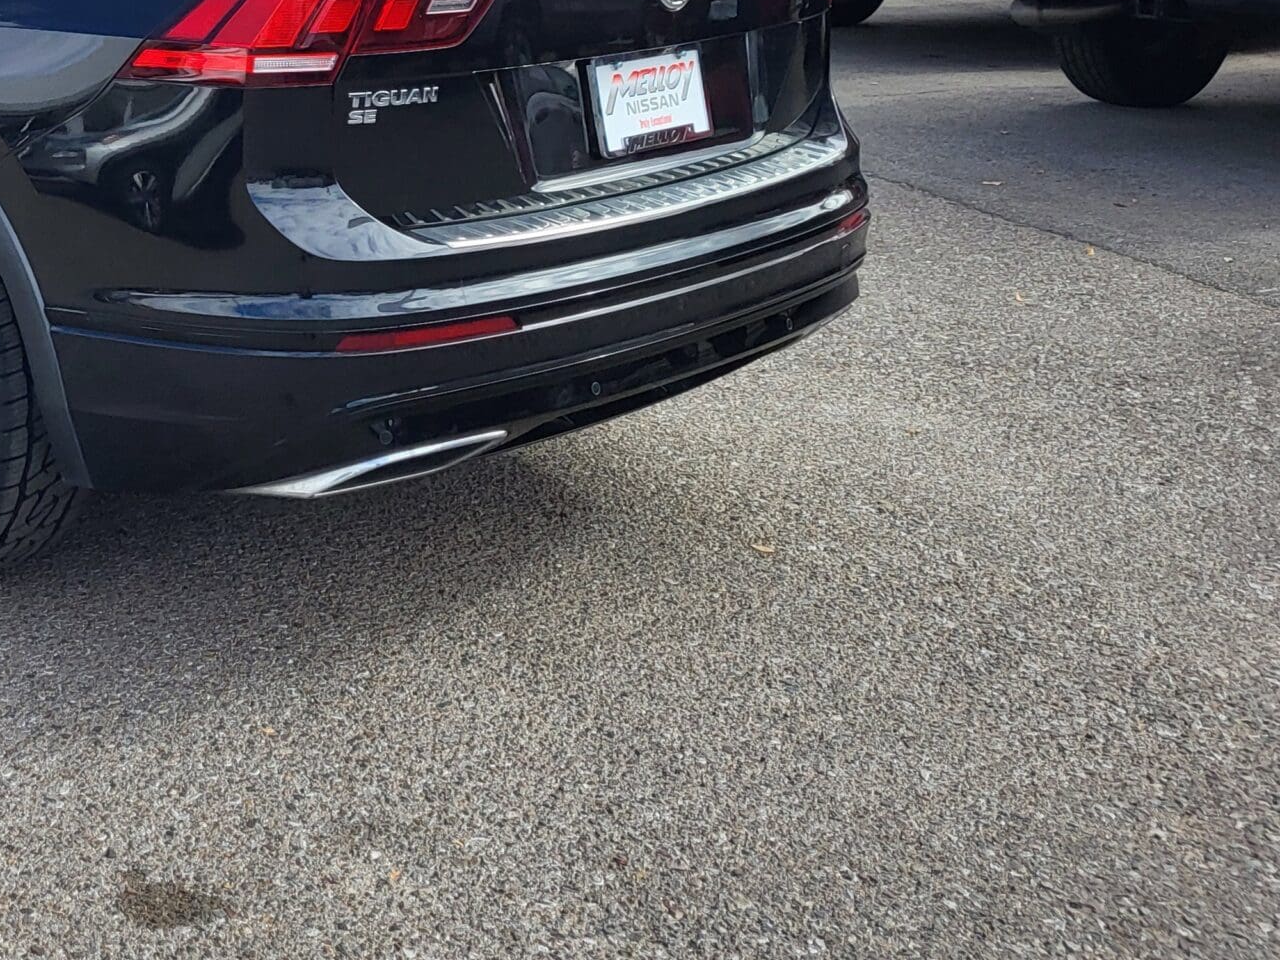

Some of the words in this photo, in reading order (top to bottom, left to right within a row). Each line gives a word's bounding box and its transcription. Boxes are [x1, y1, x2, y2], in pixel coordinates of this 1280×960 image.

[348, 86, 439, 108] TIGUAN
[606, 60, 695, 116] MELLOY
[626, 93, 680, 116] NISSAN
[347, 109, 377, 125] SE
